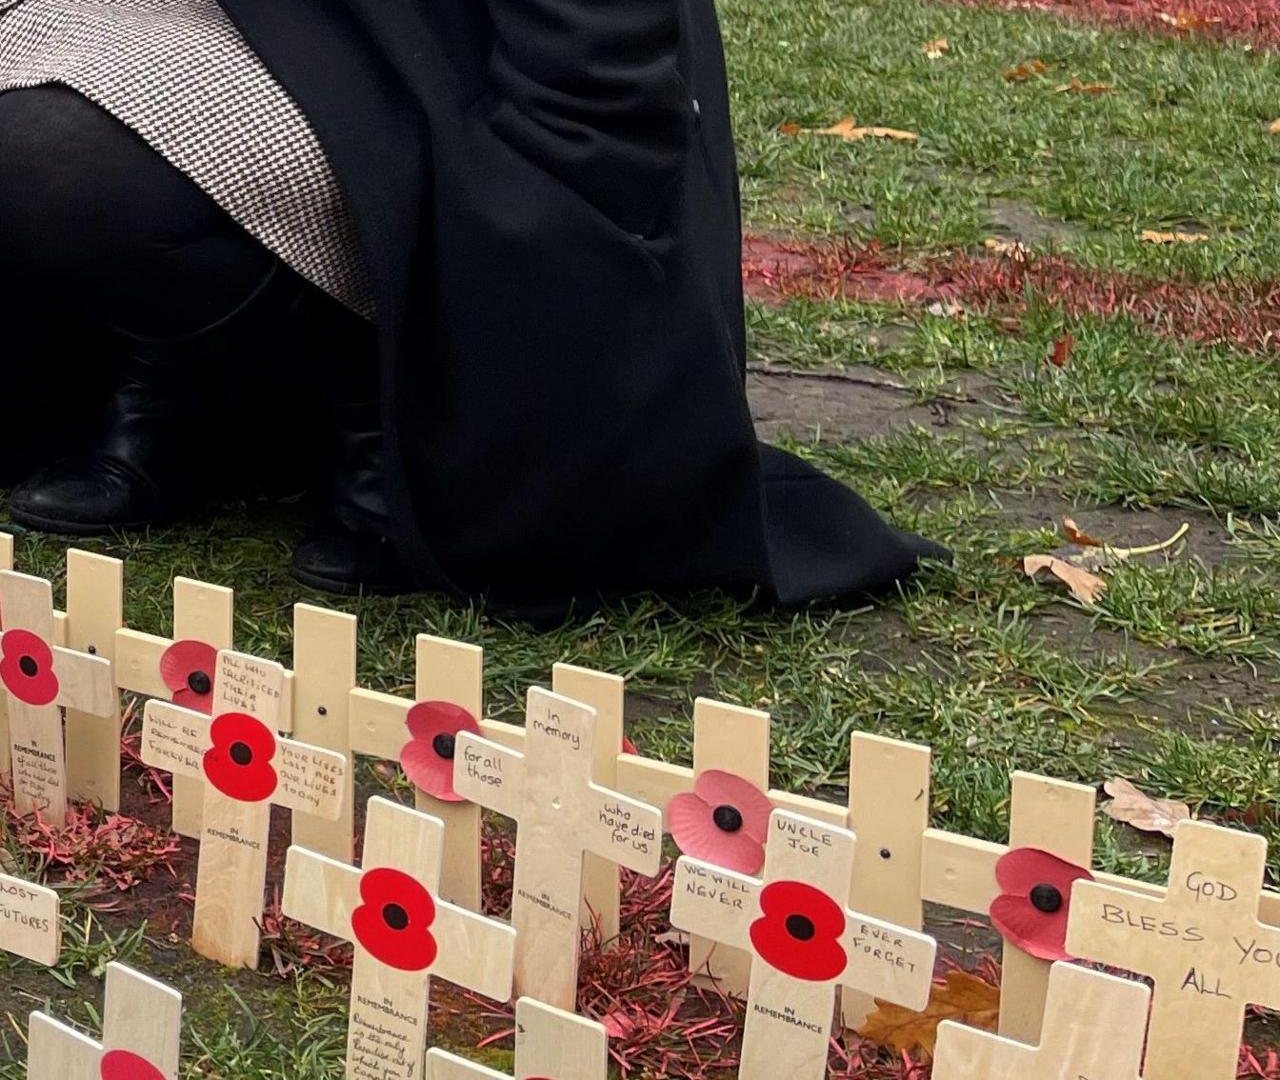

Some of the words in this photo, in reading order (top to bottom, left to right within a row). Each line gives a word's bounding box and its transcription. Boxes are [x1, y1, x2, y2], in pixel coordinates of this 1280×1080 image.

[547, 708, 560, 724] In
[533, 721, 581, 750] memory
[14, 744, 56, 762] REMEMBRANCE
[464, 745, 481, 763] for
[483, 755, 502, 772] all
[467, 762, 502, 788] those
[604, 803, 631, 821] who
[207, 827, 261, 850] REMEMBRANCE
[599, 811, 628, 833] have
[631, 822, 655, 841] died
[611, 831, 629, 844] for
[777, 819, 833, 846] UNCLE
[787, 838, 820, 857] JOE
[0, 882, 38, 901] LOST
[684, 864, 707, 877] WE
[713, 873, 751, 893] WILL
[1186, 871, 1237, 902] GOD
[517, 889, 572, 920] REMEMBRANCE
[686, 882, 744, 910] NEVER
[860, 924, 903, 947] EVER
[1101, 904, 1204, 942] BLESS
[852, 937, 916, 973] FORGET
[1180, 968, 1232, 999] ALL
[357, 995, 417, 1026] REMEMBRANCE
[384, 997, 392, 1006] IN
[784, 1006, 795, 1016] IN
[754, 1004, 823, 1035] REMEMBRANCE
